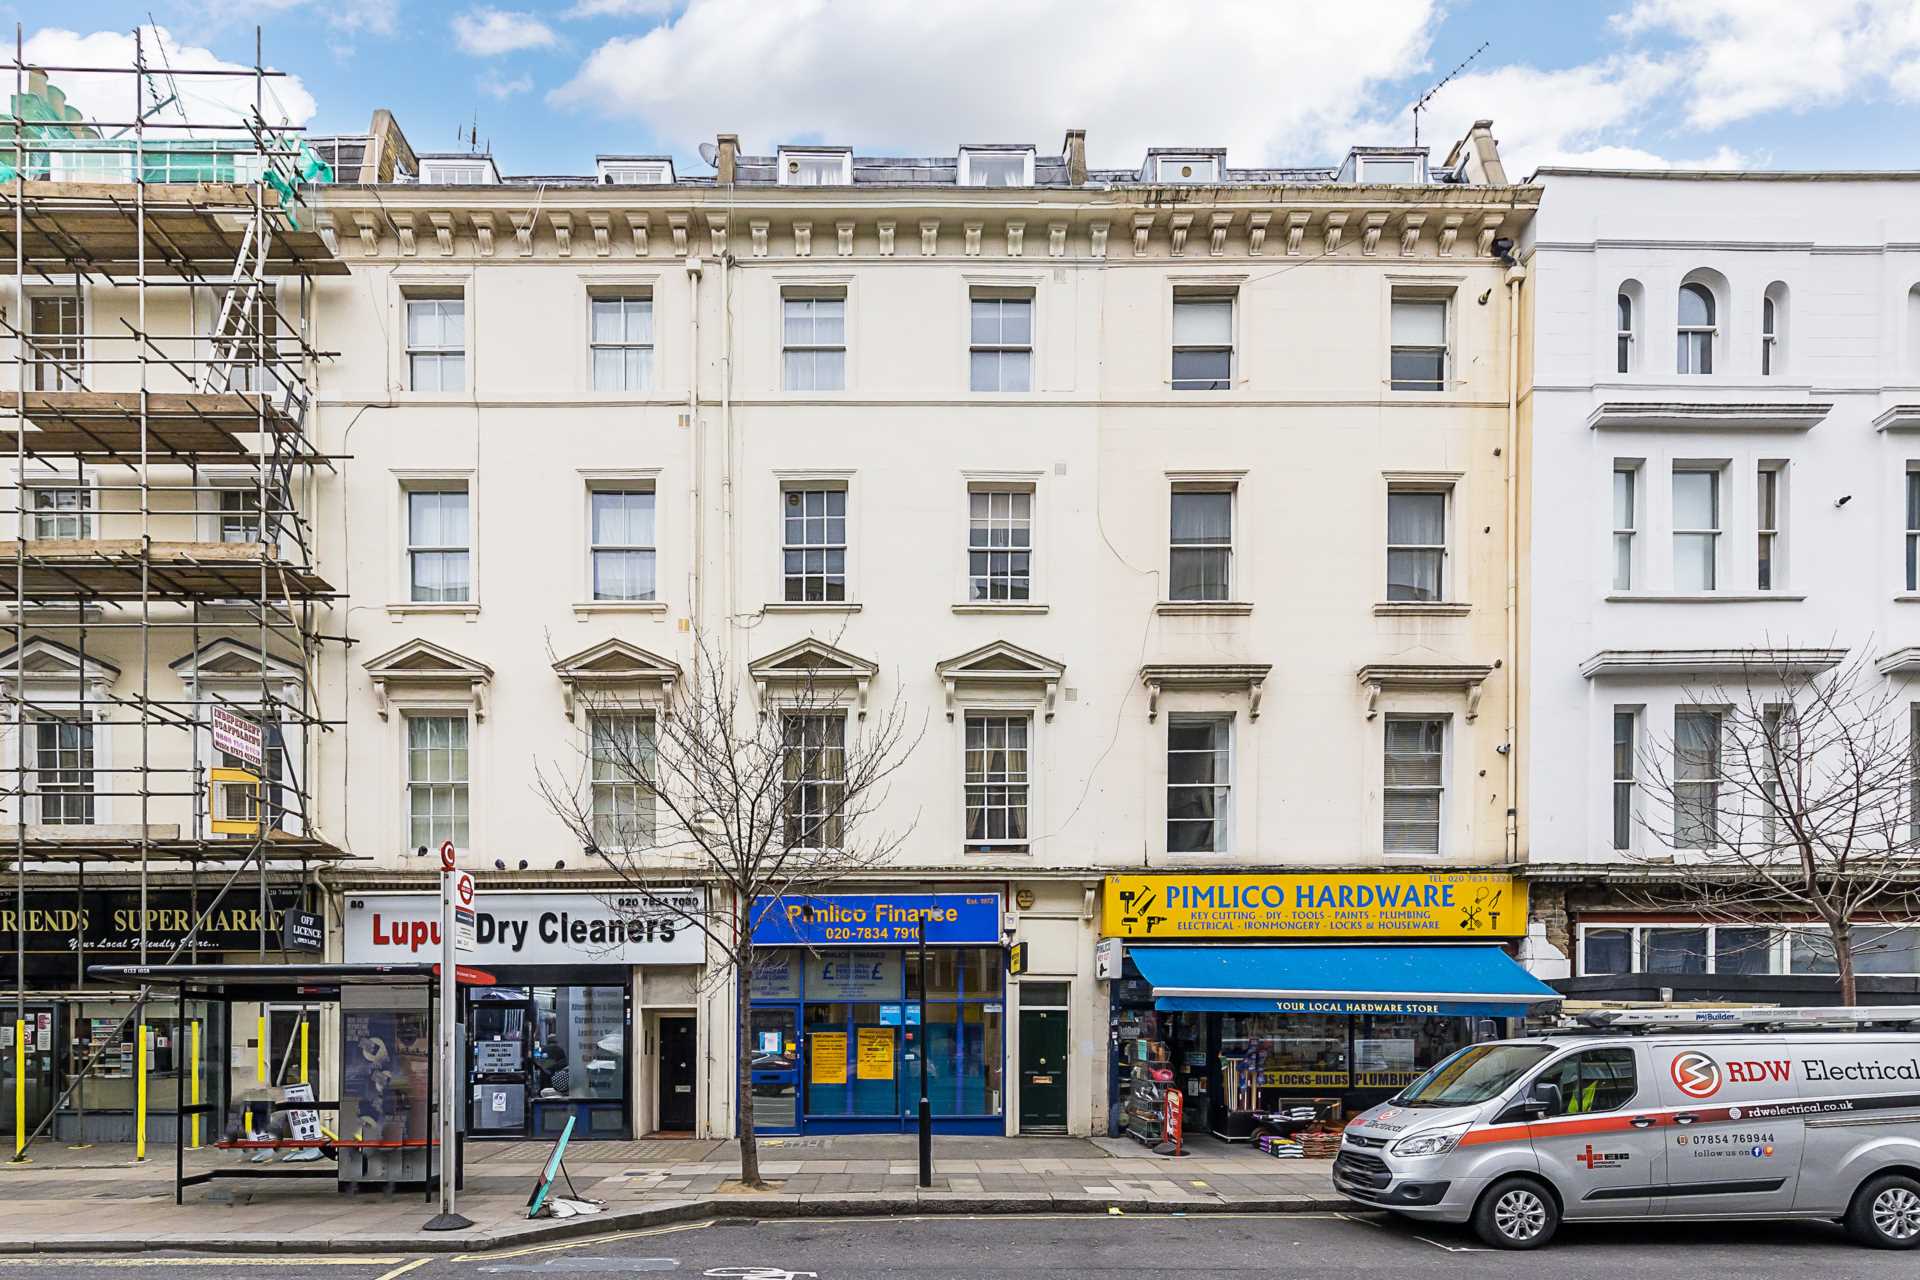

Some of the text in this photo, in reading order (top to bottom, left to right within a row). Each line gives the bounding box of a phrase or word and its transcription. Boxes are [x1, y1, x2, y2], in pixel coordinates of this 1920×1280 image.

[1166, 884, 1456, 908] PIMLICO HARDWARE
[350, 900, 364, 909] 80
[618, 897, 639, 908] 020
[113, 909, 287, 932] SUPERMARKE
[301, 915, 314, 926] OFF
[1191, 910, 1431, 920] KEY CUTTING DIY TOOLS PAINTS PLUMBING
[1177, 921, 1234, 930] ELECTRICAL
[1244, 921, 1321, 930] IRONMONGERY
[1330, 921, 1362, 929] LOCKS
[1378, 920, 1440, 929] HOUSEWARE
[293, 924, 322, 939] LICENCE
[372, 911, 676, 952] Lupu Dry Cleaners
[826, 927, 889, 940] 020-7834
[97, 938, 128, 948] Local
[1276, 1001, 1439, 1013] YOUR LOCAL HARDWARE STORE
[1726, 1058, 1920, 1082] RDW Electrical
[1748, 1101, 1854, 1118] rdwelectrical.co.uk
[1692, 1132, 1775, 1145] 07854 769944
[1694, 1149, 1724, 1158] follow
[1738, 1149, 1750, 1157] on
